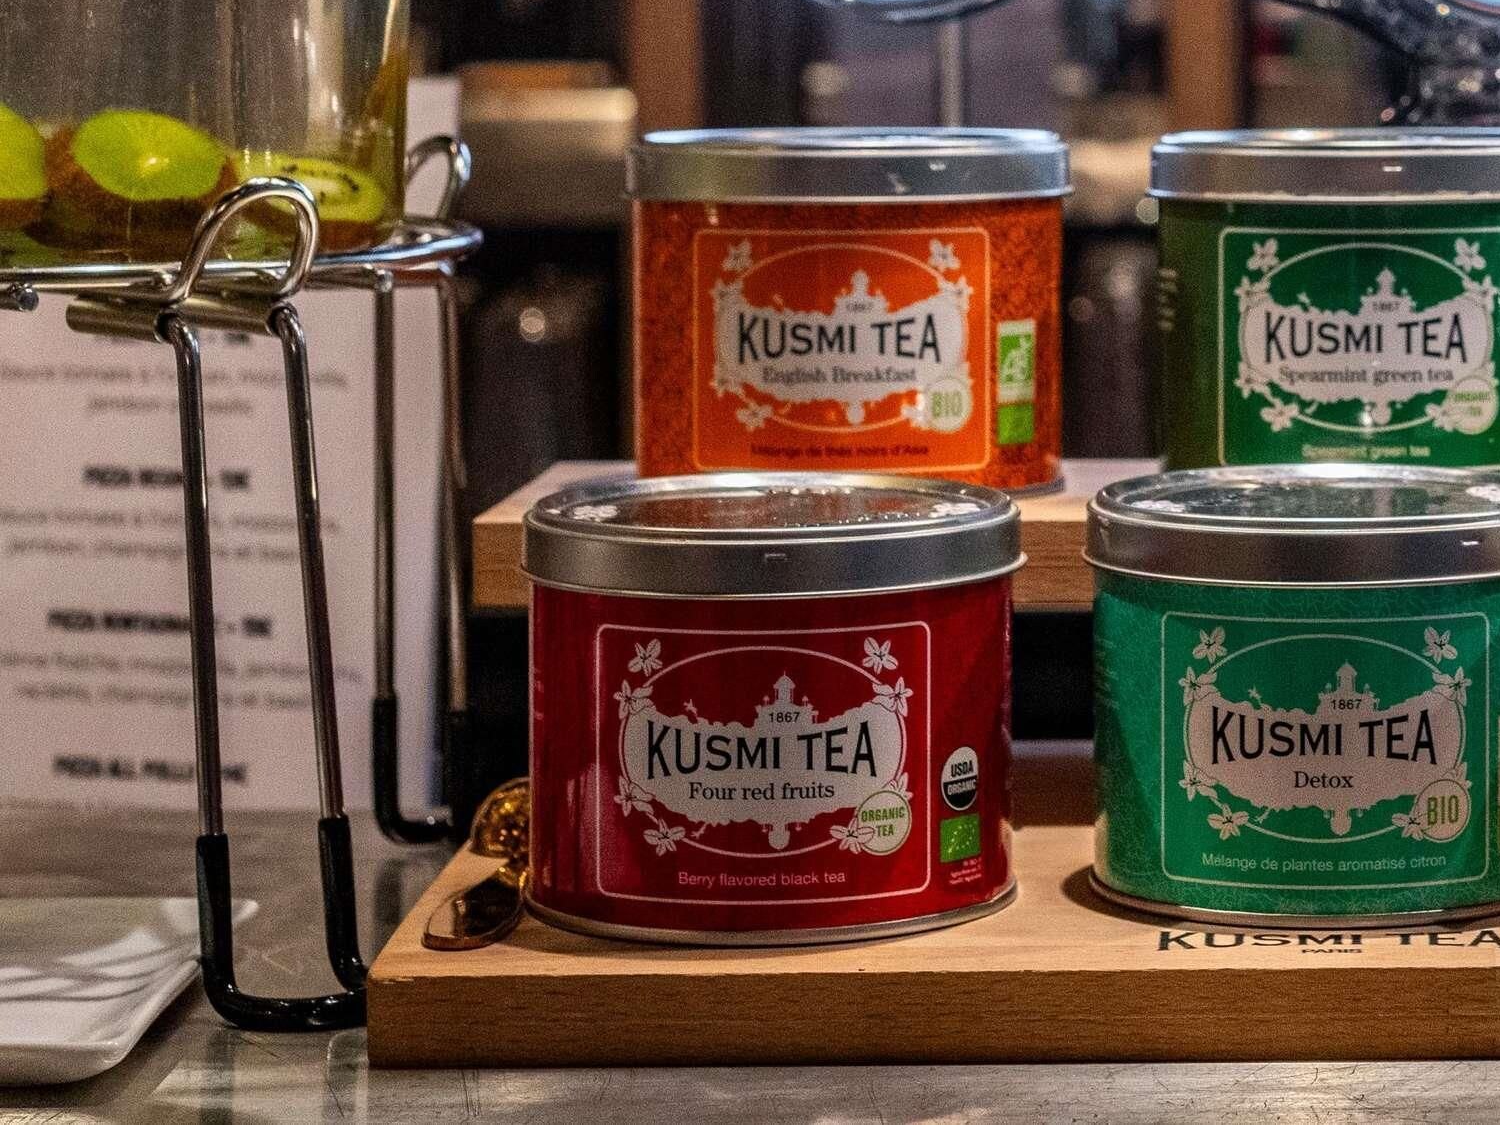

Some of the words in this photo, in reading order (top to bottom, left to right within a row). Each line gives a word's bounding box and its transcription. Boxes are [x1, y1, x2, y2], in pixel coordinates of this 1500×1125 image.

[738, 313, 855, 363] KUSMI
[871, 313, 941, 363] TEA
[1265, 312, 1384, 363] KUSMI
[1398, 313, 1467, 363] TEA
[762, 366, 828, 386] English
[832, 366, 918, 383] Breakfast
[1279, 366, 1367, 385] Spearmint
[1372, 368, 1422, 386] green
[1427, 367, 1453, 381] tea
[931, 391, 963, 418] BIO
[1330, 699, 1362, 710] 1867
[768, 712, 800, 723] 1867
[1211, 706, 1342, 764] KUSMI
[1359, 709, 1437, 764] TEA
[647, 720, 780, 780] KUSMI
[797, 721, 877, 777] TEA
[950, 760, 974, 777] USDA
[947, 779, 977, 795] ORGANIC
[1294, 771, 1353, 788] Detox
[689, 782, 736, 800] Four
[742, 783, 775, 800] red
[782, 782, 835, 799] fruits
[861, 807, 905, 822] ORGANIC
[1427, 795, 1459, 825] BIO
[876, 825, 894, 837] TEA
[1202, 853, 1256, 871] Mélange
[1261, 857, 1278, 870] de
[1283, 859, 1334, 873] plantes
[1338, 858, 1405, 871] aromatisé
[1410, 855, 1447, 868] citron
[678, 872, 715, 889] Berry
[719, 873, 776, 886] flavored
[781, 871, 819, 886] black
[824, 872, 846, 883] tea
[1157, 930, 1362, 952] KUSMI
